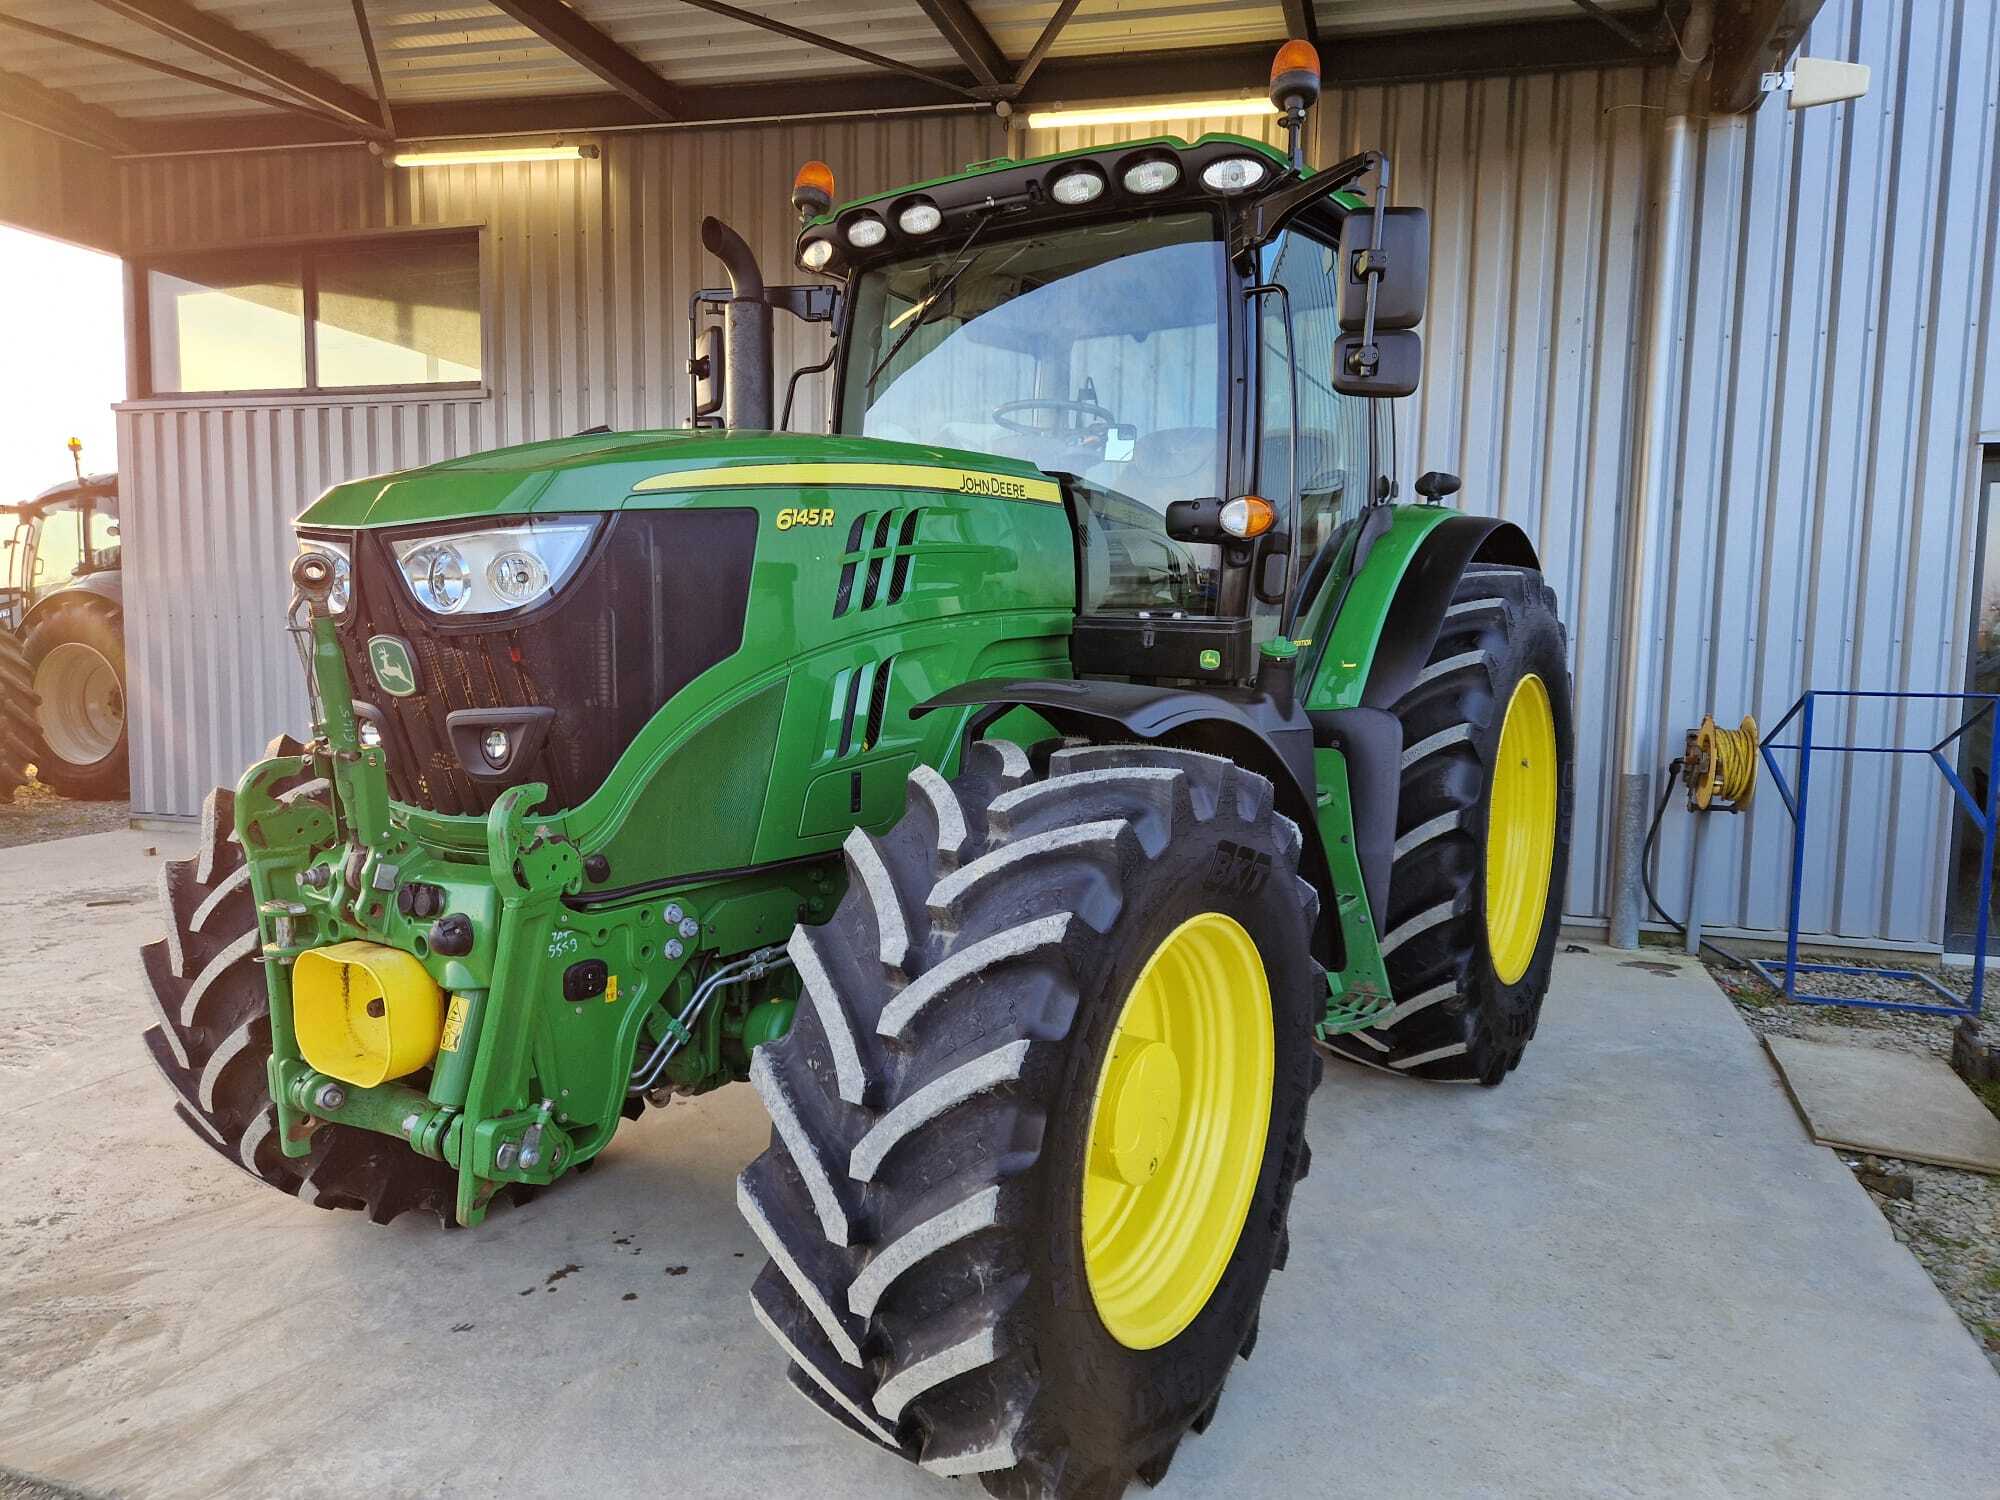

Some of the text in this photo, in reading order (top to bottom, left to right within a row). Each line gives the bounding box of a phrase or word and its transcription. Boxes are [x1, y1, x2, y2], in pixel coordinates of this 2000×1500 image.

[960, 473, 1026, 498] JOHN DEERE
[776, 508, 836, 531] 6145R
